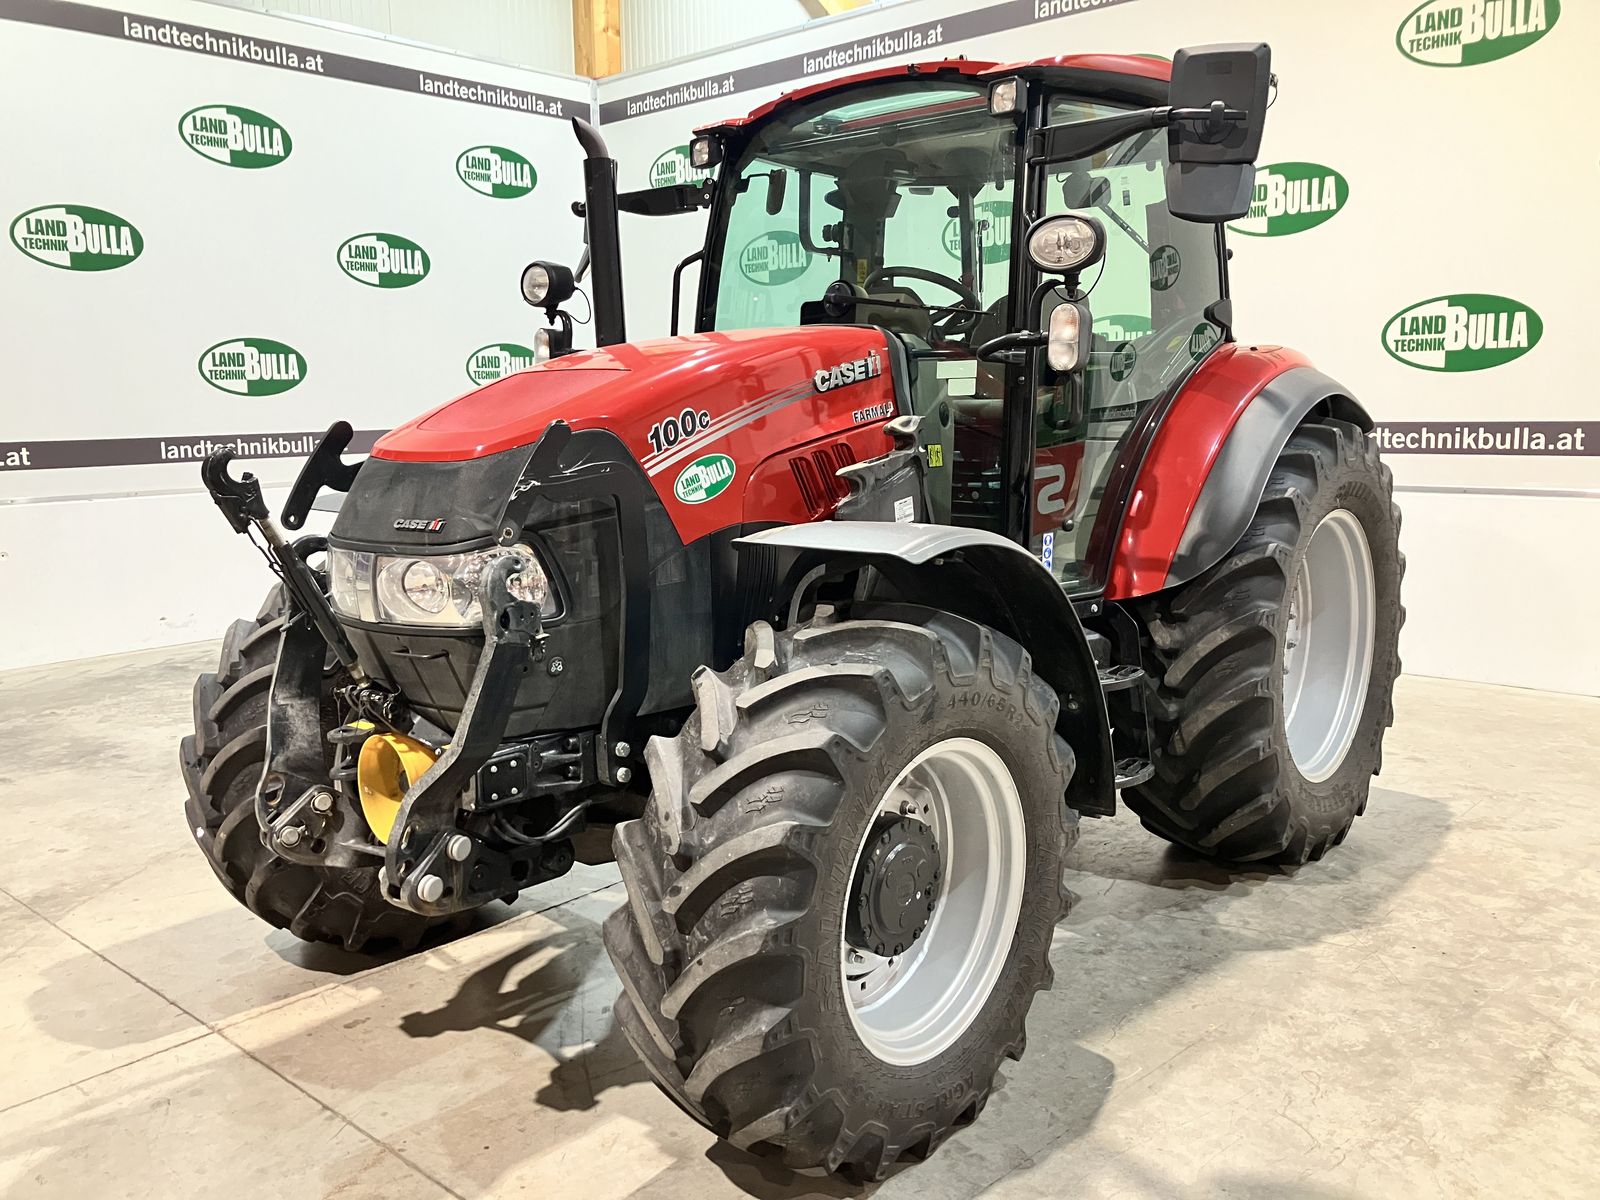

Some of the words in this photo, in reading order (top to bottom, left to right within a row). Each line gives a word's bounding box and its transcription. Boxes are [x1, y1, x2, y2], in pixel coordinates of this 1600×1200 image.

[1415, 7, 1463, 35] LAND
[1463, 0, 1546, 45] BULLA
[123, 16, 324, 73] landtechnikbulla.at
[803, 23, 943, 74] landtechnikbulla.at
[1408, 30, 1463, 53] TECHNIK
[419, 73, 563, 117] landtechnikbulla.at
[627, 75, 735, 116] landtechnikbulla.at
[192, 115, 228, 135] LAND
[228, 114, 285, 157] BULLA
[188, 133, 230, 149] TECHNIK
[466, 155, 491, 171] LAND
[491, 153, 532, 188] BULLA
[656, 160, 676, 176] LAND
[463, 170, 492, 183] TECHNIK
[1267, 173, 1337, 217] BULLA
[25, 217, 68, 238] LAND
[67, 213, 135, 257] BULLA
[21, 237, 69, 252] TECHNIK
[348, 244, 377, 260] LAND
[747, 246, 768, 262] LAND
[768, 239, 807, 271] BULLA
[345, 260, 379, 273] TECHNIK
[377, 240, 425, 276] BULLA
[1400, 315, 1447, 336] LAND
[1446, 305, 1529, 351] BULLA
[1393, 337, 1446, 353] TECHNIK
[211, 352, 246, 368] LAND
[245, 346, 300, 381] BULLA
[475, 355, 500, 369] LAND
[208, 369, 247, 380] TECHNIK
[473, 370, 501, 380] TECHNIK
[814, 359, 866, 392] CASE
[681, 473, 701, 490] LAND
[699, 458, 732, 489] BULLA
[393, 518, 429, 530] CASE
